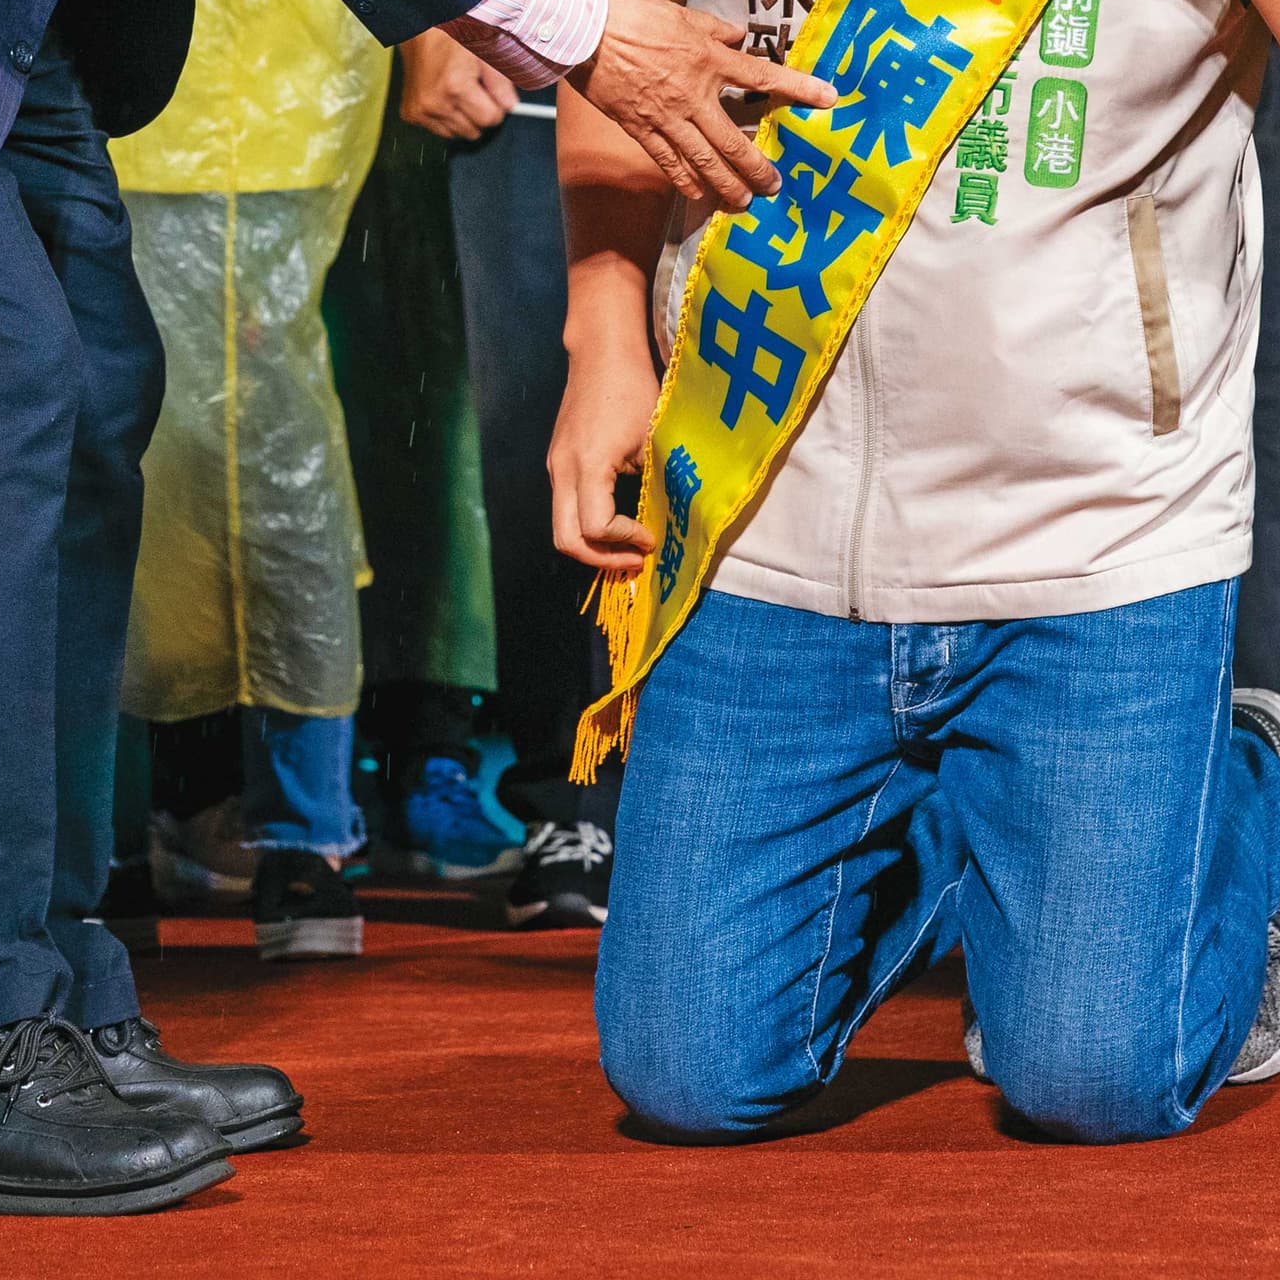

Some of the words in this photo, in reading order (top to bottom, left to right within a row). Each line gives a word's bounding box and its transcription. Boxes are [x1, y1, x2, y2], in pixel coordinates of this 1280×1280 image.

[950, 50, 1020, 226] 市議員
[1033, 90, 1079, 175] 小港
